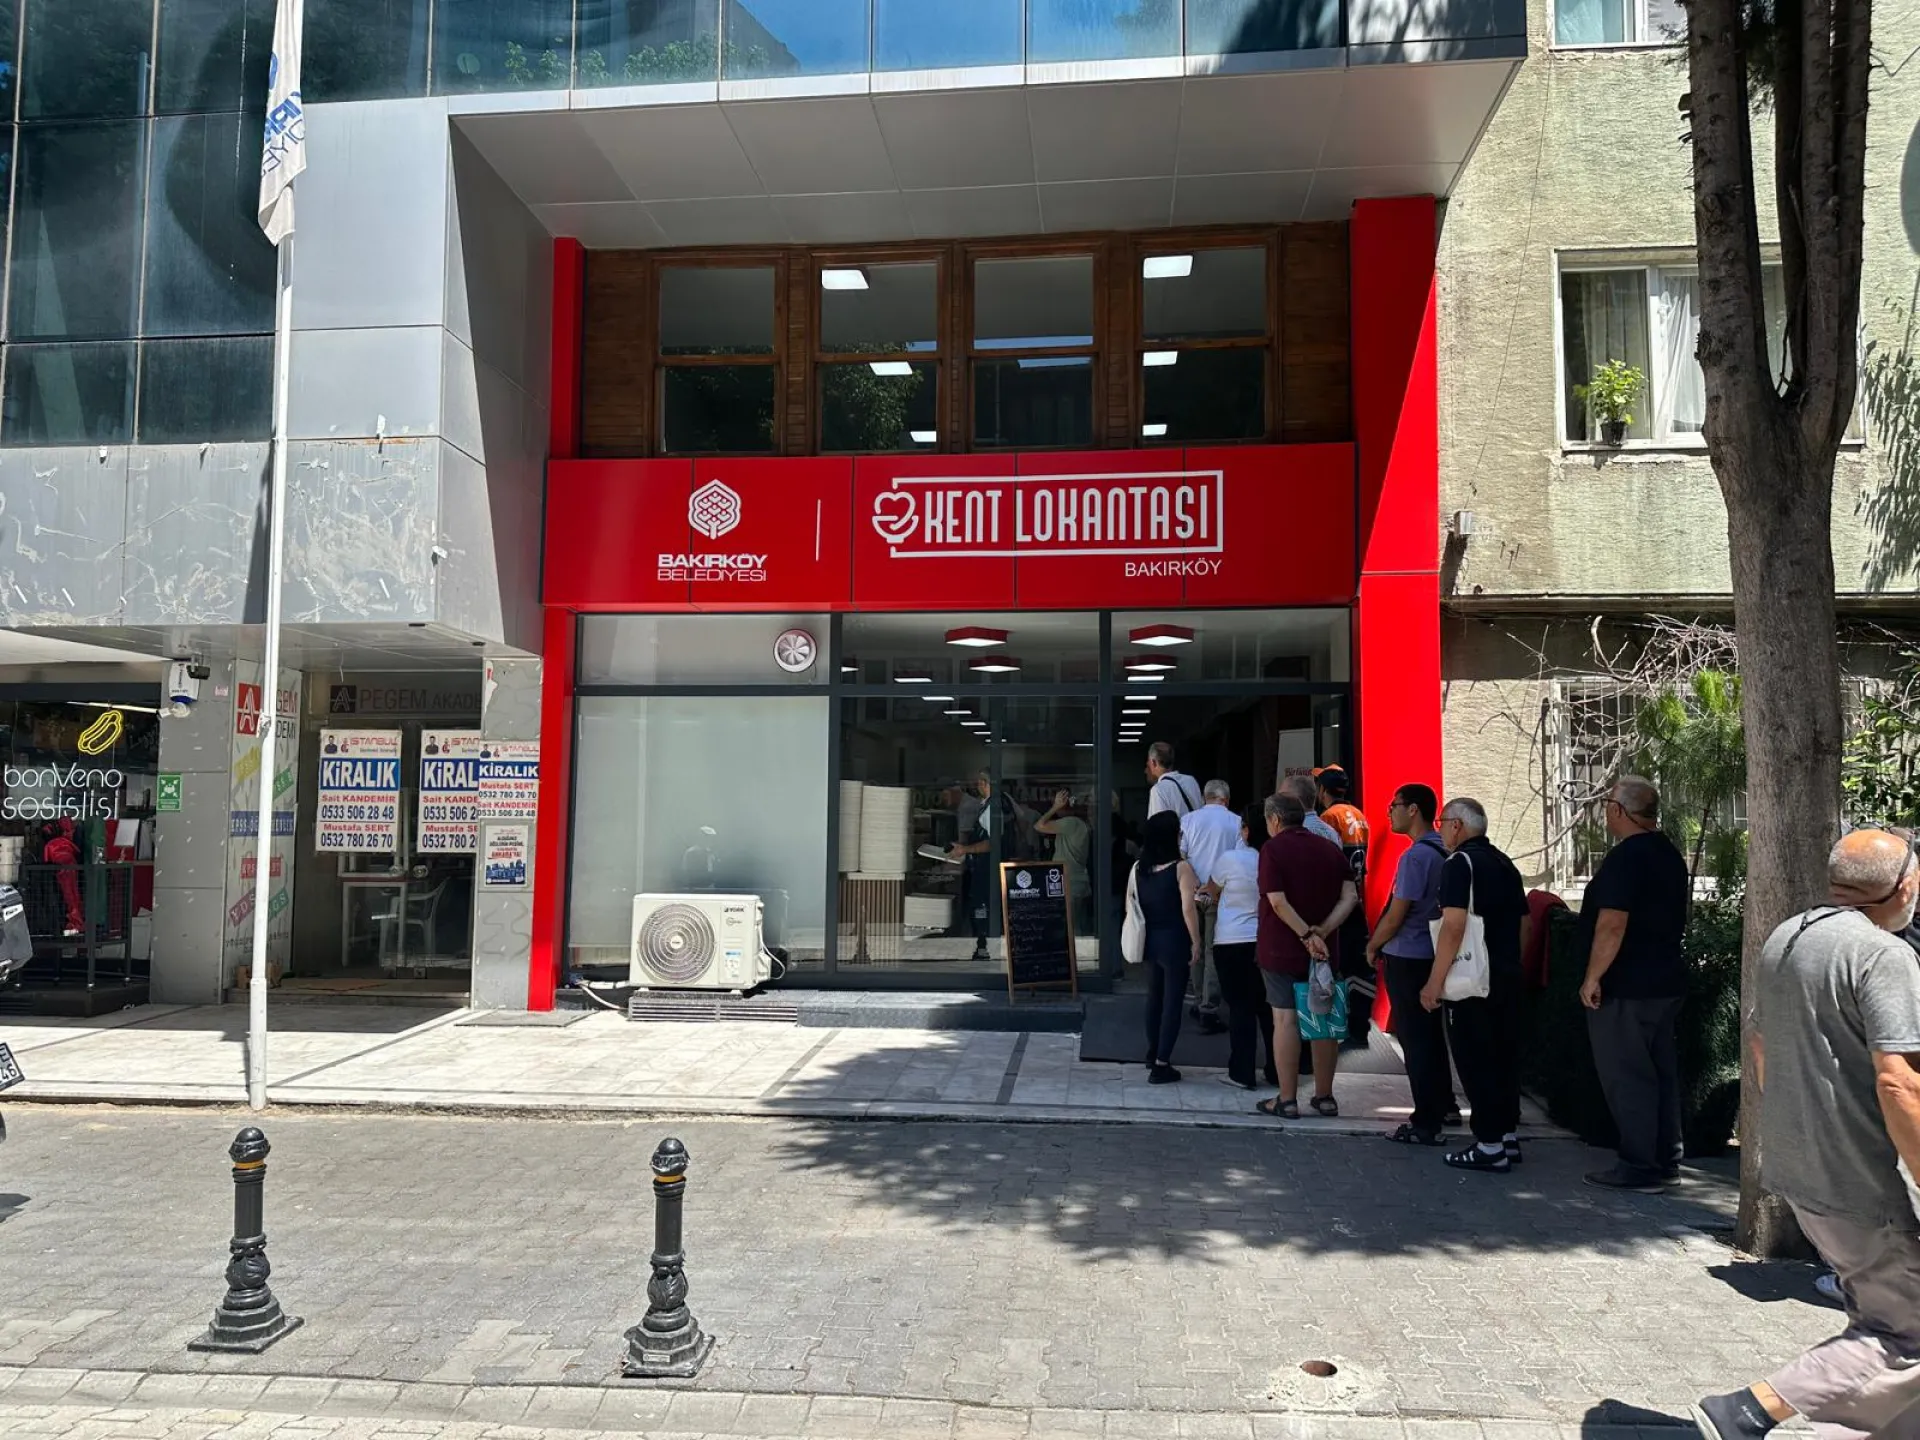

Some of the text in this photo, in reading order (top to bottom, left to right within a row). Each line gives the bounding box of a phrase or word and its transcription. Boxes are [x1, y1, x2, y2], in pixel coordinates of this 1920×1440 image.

[924, 484, 1208, 544] KENT LOKANTASI
[657, 553, 768, 568] BAKIRKÖY
[1125, 558, 1222, 577] BAKIRKÖY
[360, 688, 428, 710] PEGEM
[431, 690, 482, 710] AKADE
[423, 761, 480, 789] KiRAL
[480, 782, 534, 790] Mustafa SERT
[322, 794, 341, 803] Sait
[478, 791, 537, 799] 0532 780 26 70
[321, 805, 395, 820] 0533 506 28 48
[423, 806, 479, 821] 0533 506 2
[477, 809, 536, 817] 0533 506 28 48
[323, 823, 391, 832] Mustafa SERT
[425, 825, 464, 833] Mustafa
[320, 833, 393, 848] 0532 780 26 70
[422, 834, 446, 848] 0532
[448, 834, 467, 849] 780
[469, 835, 478, 849] 2
